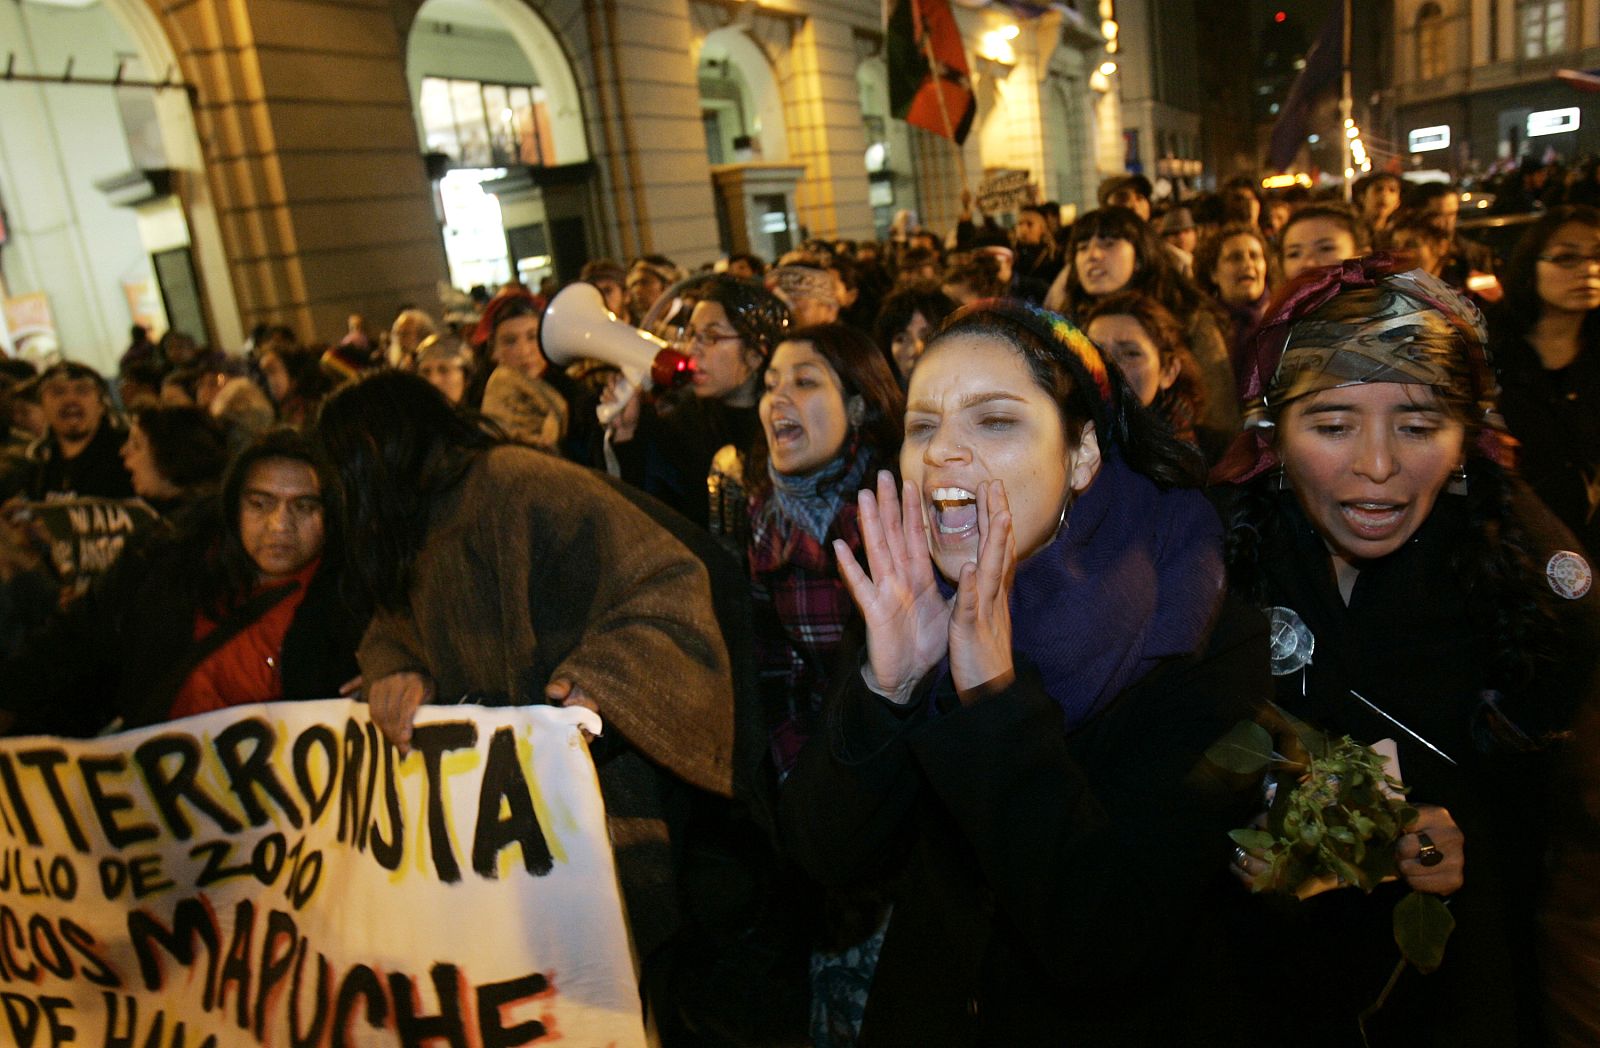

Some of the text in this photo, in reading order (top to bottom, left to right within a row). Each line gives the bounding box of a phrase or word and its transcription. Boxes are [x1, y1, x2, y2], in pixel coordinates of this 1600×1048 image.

[0, 716, 556, 886] ITERRORISTA
[98, 853, 175, 901] DE
[188, 832, 323, 910] 2010
[0, 904, 122, 988] COS
[127, 896, 552, 1048] MAPUCHE
